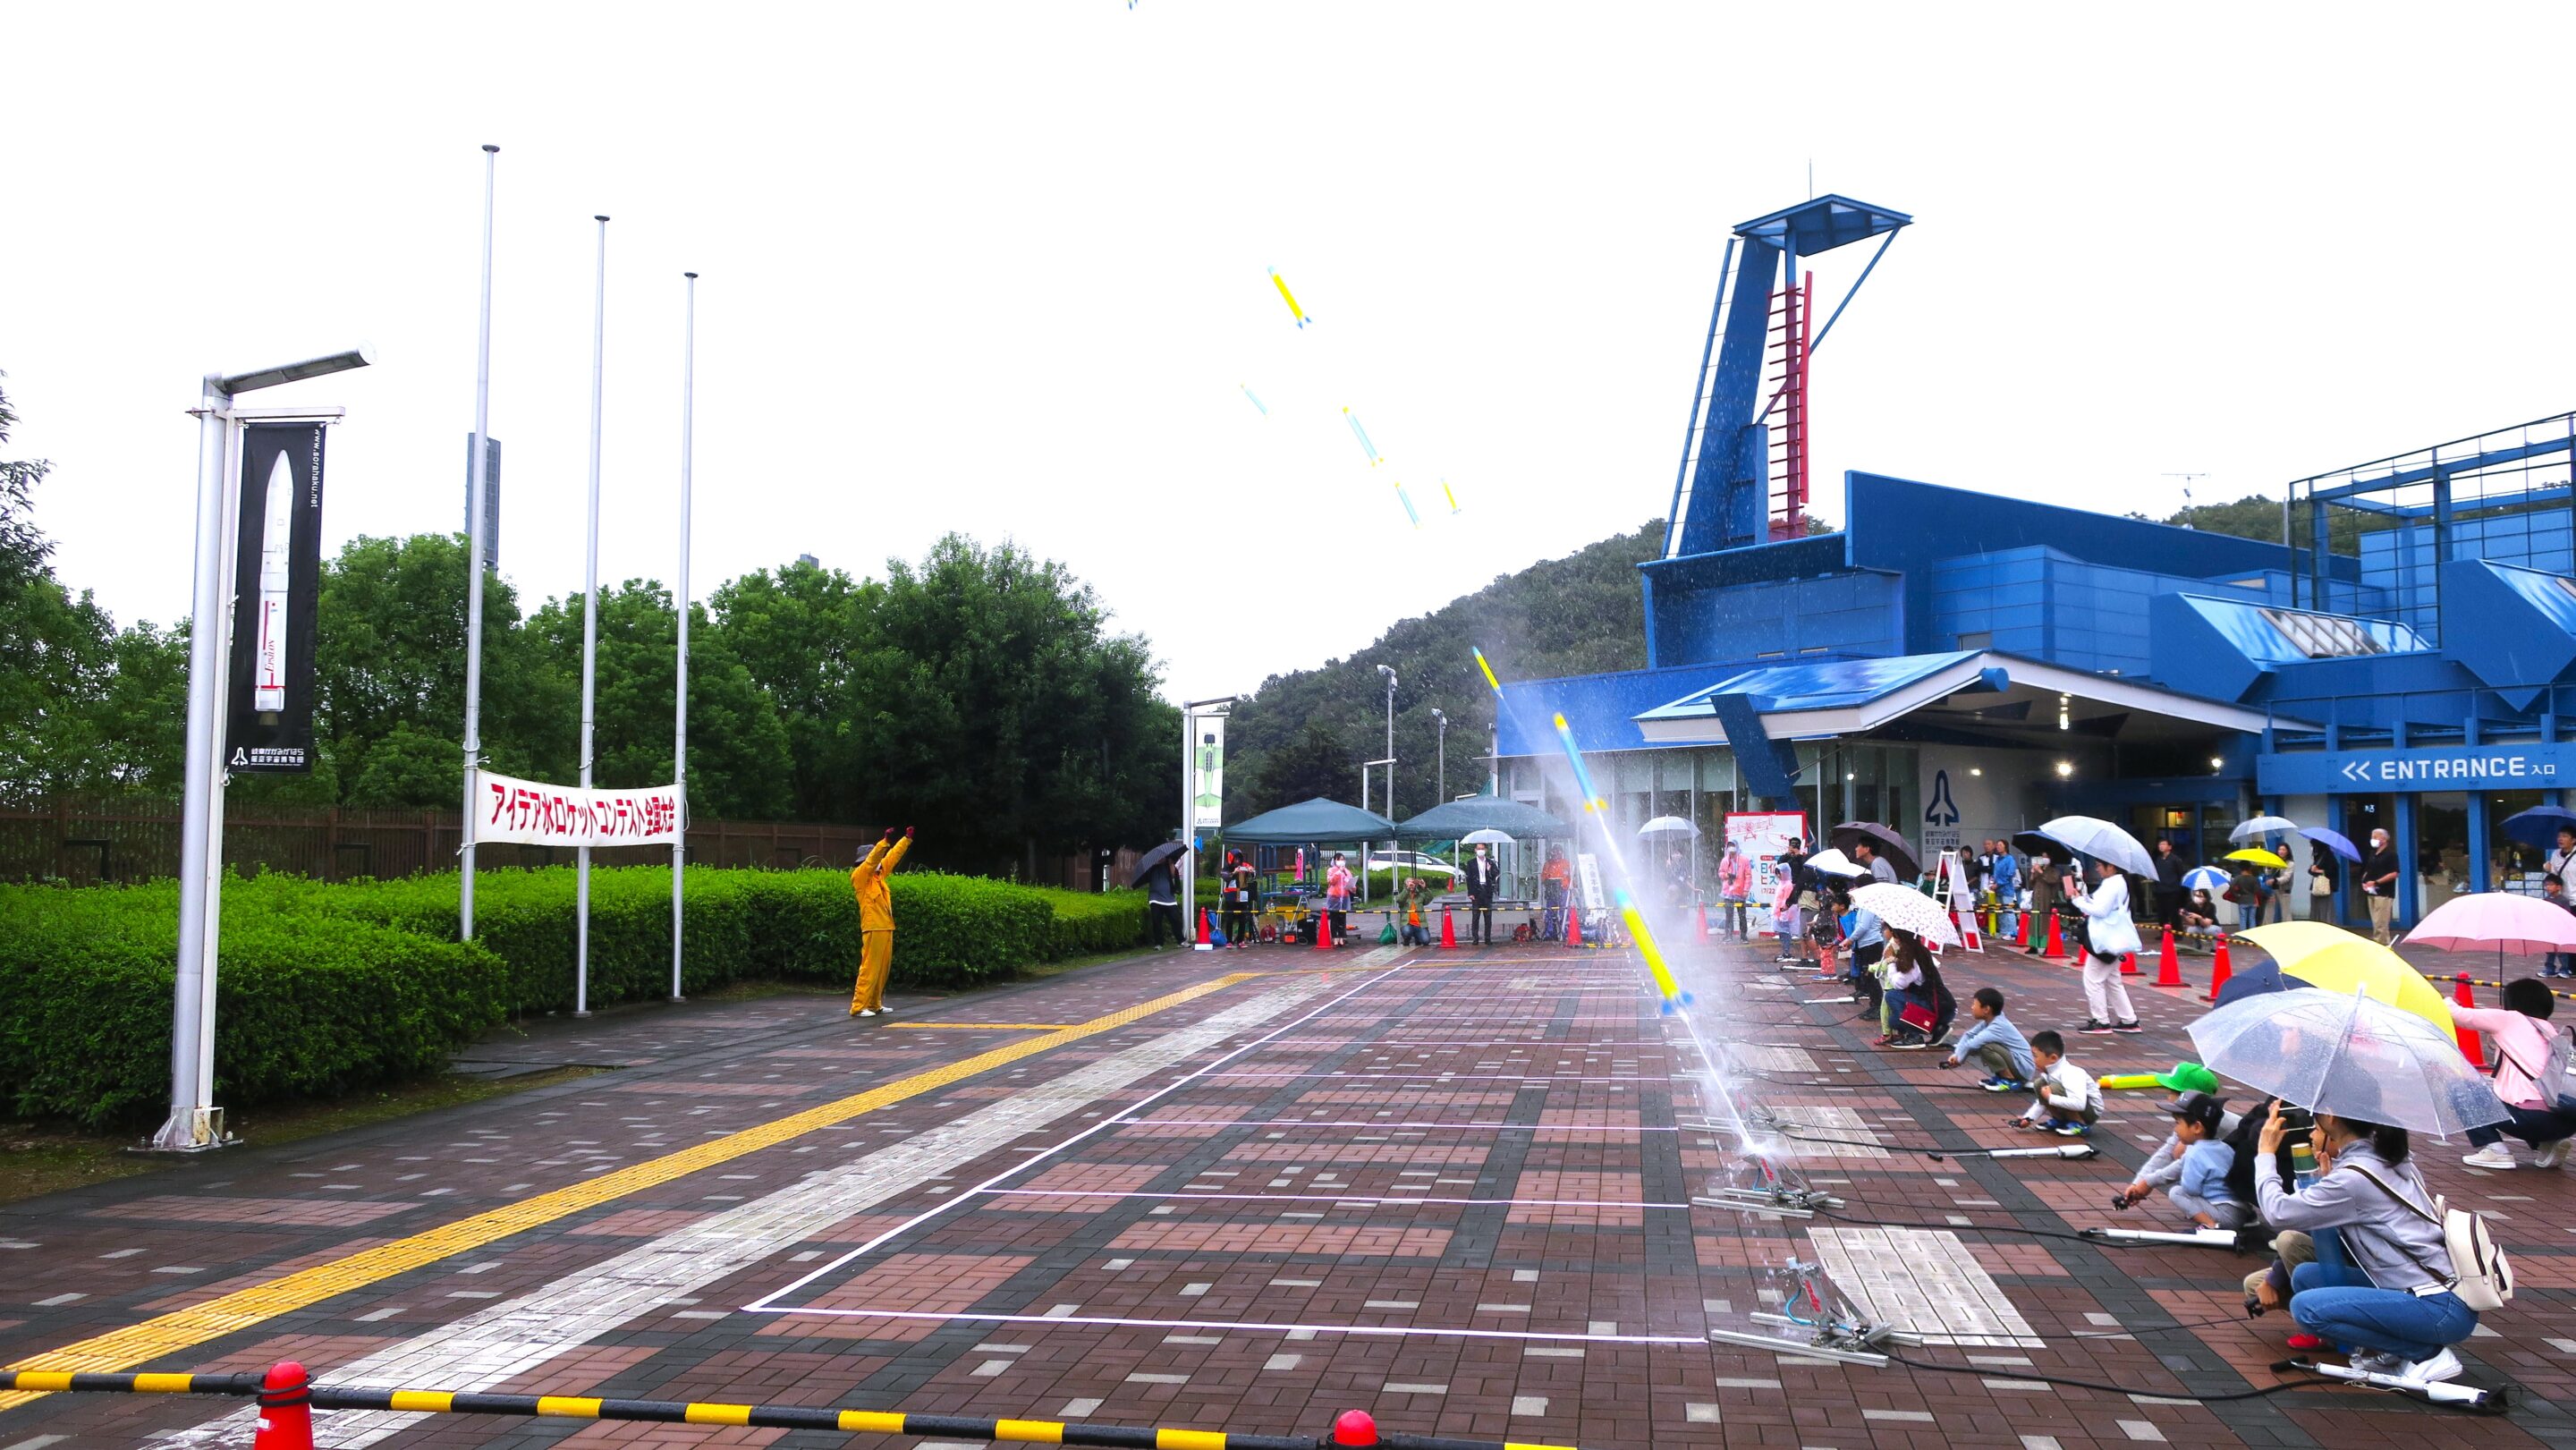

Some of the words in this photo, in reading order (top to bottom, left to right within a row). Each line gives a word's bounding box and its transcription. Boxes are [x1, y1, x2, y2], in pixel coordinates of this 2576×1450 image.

[310, 428, 321, 508] www.sorahaku.net
[2381, 757, 2525, 780] ENTRANCE
[2531, 764, 2555, 776] 入口
